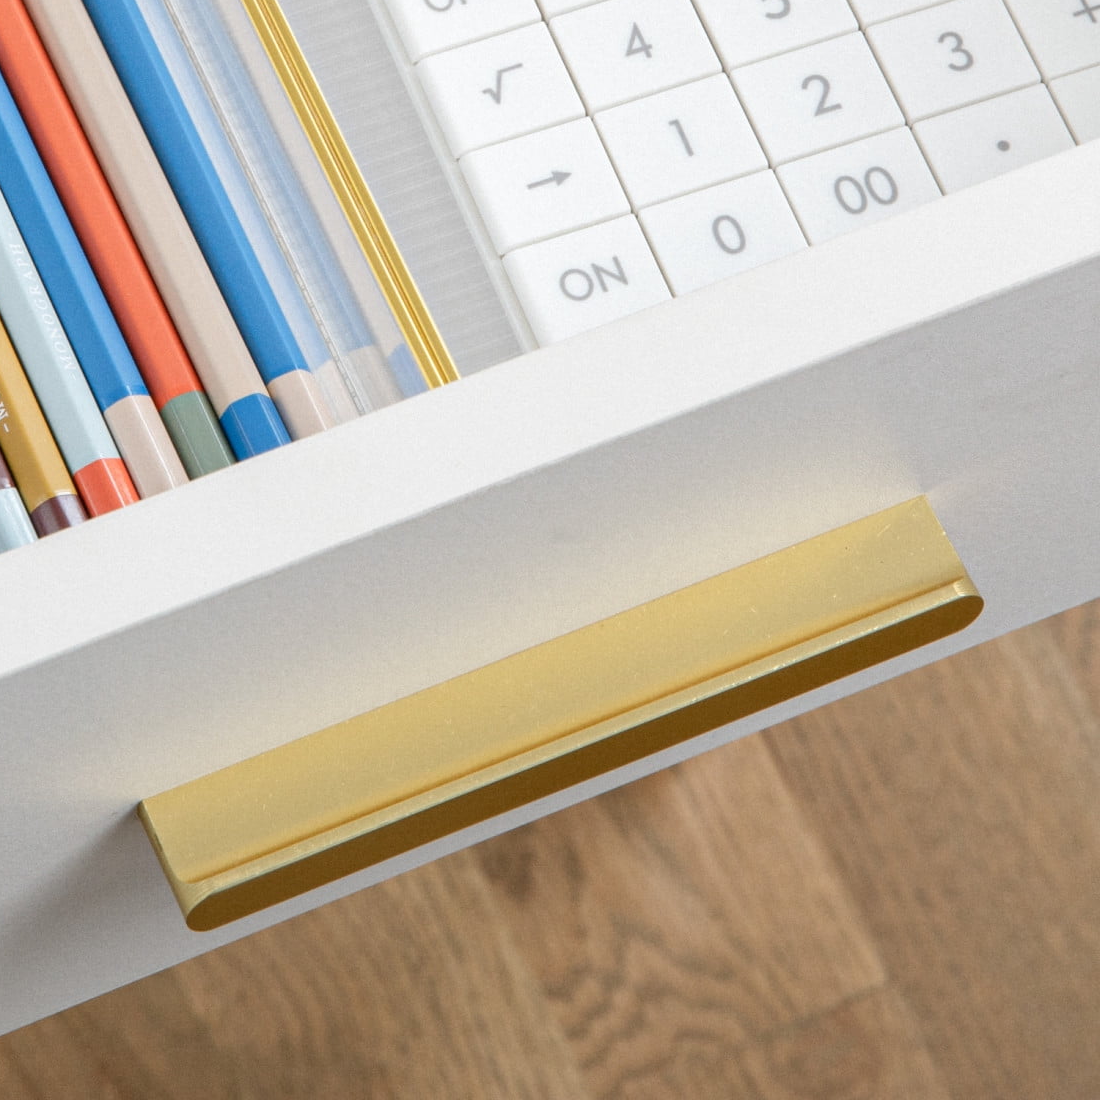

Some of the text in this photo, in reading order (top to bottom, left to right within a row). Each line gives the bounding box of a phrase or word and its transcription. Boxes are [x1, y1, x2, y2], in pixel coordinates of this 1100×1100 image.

[625, 22, 652, 58] 4
[938, 31, 974, 72] 3
[802, 75, 842, 116] 2
[668, 119, 694, 156] 1
[834, 166, 898, 214] 00
[712, 215, 746, 255] 0
[559, 256, 628, 301] ON
